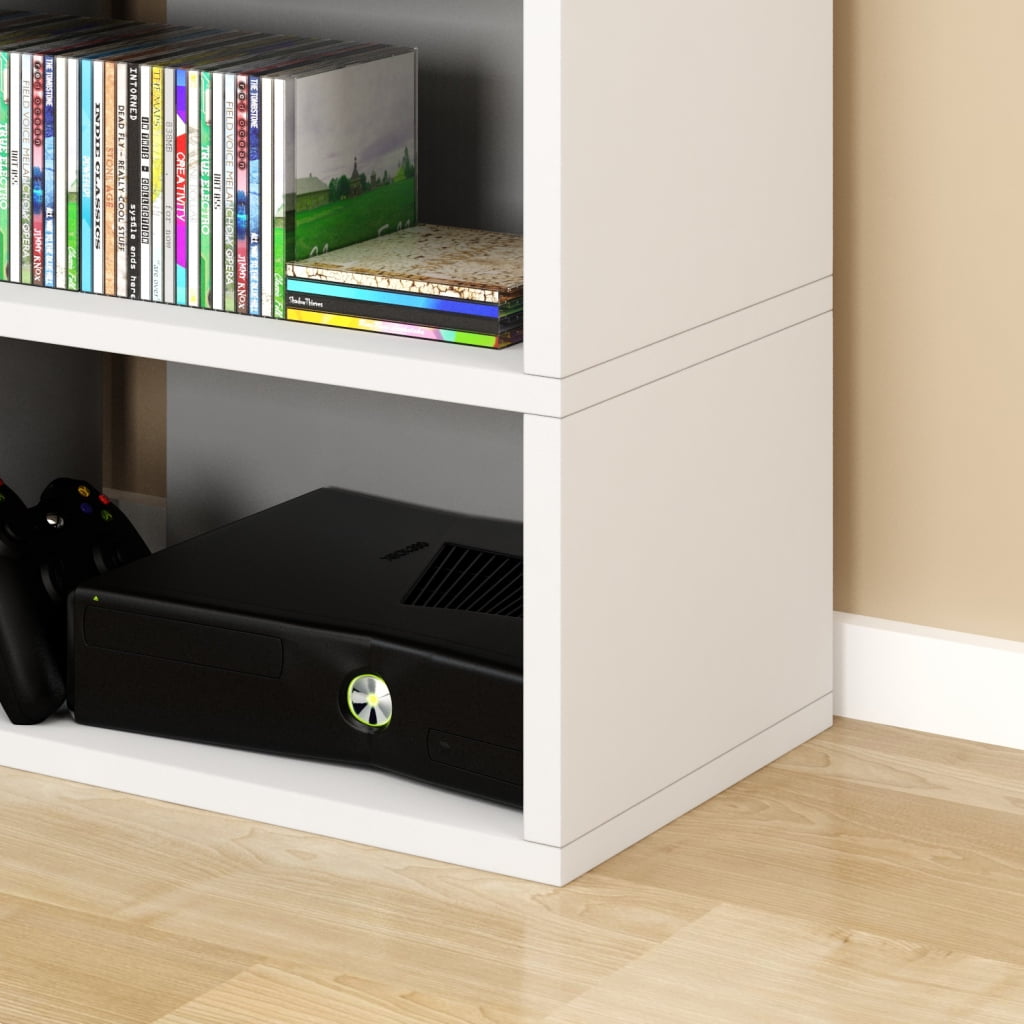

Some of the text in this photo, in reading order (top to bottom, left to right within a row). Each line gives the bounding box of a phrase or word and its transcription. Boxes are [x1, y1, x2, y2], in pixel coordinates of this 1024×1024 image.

[22, 80, 30, 108] FIELD
[22, 111, 30, 144] VOICE
[0, 123, 8, 210] TRUE ELECTRO
[176, 152, 186, 222] CREATIVITY
[202, 180, 210, 235] ELECTRO
[238, 254, 246, 308] JIMMY KNOX
